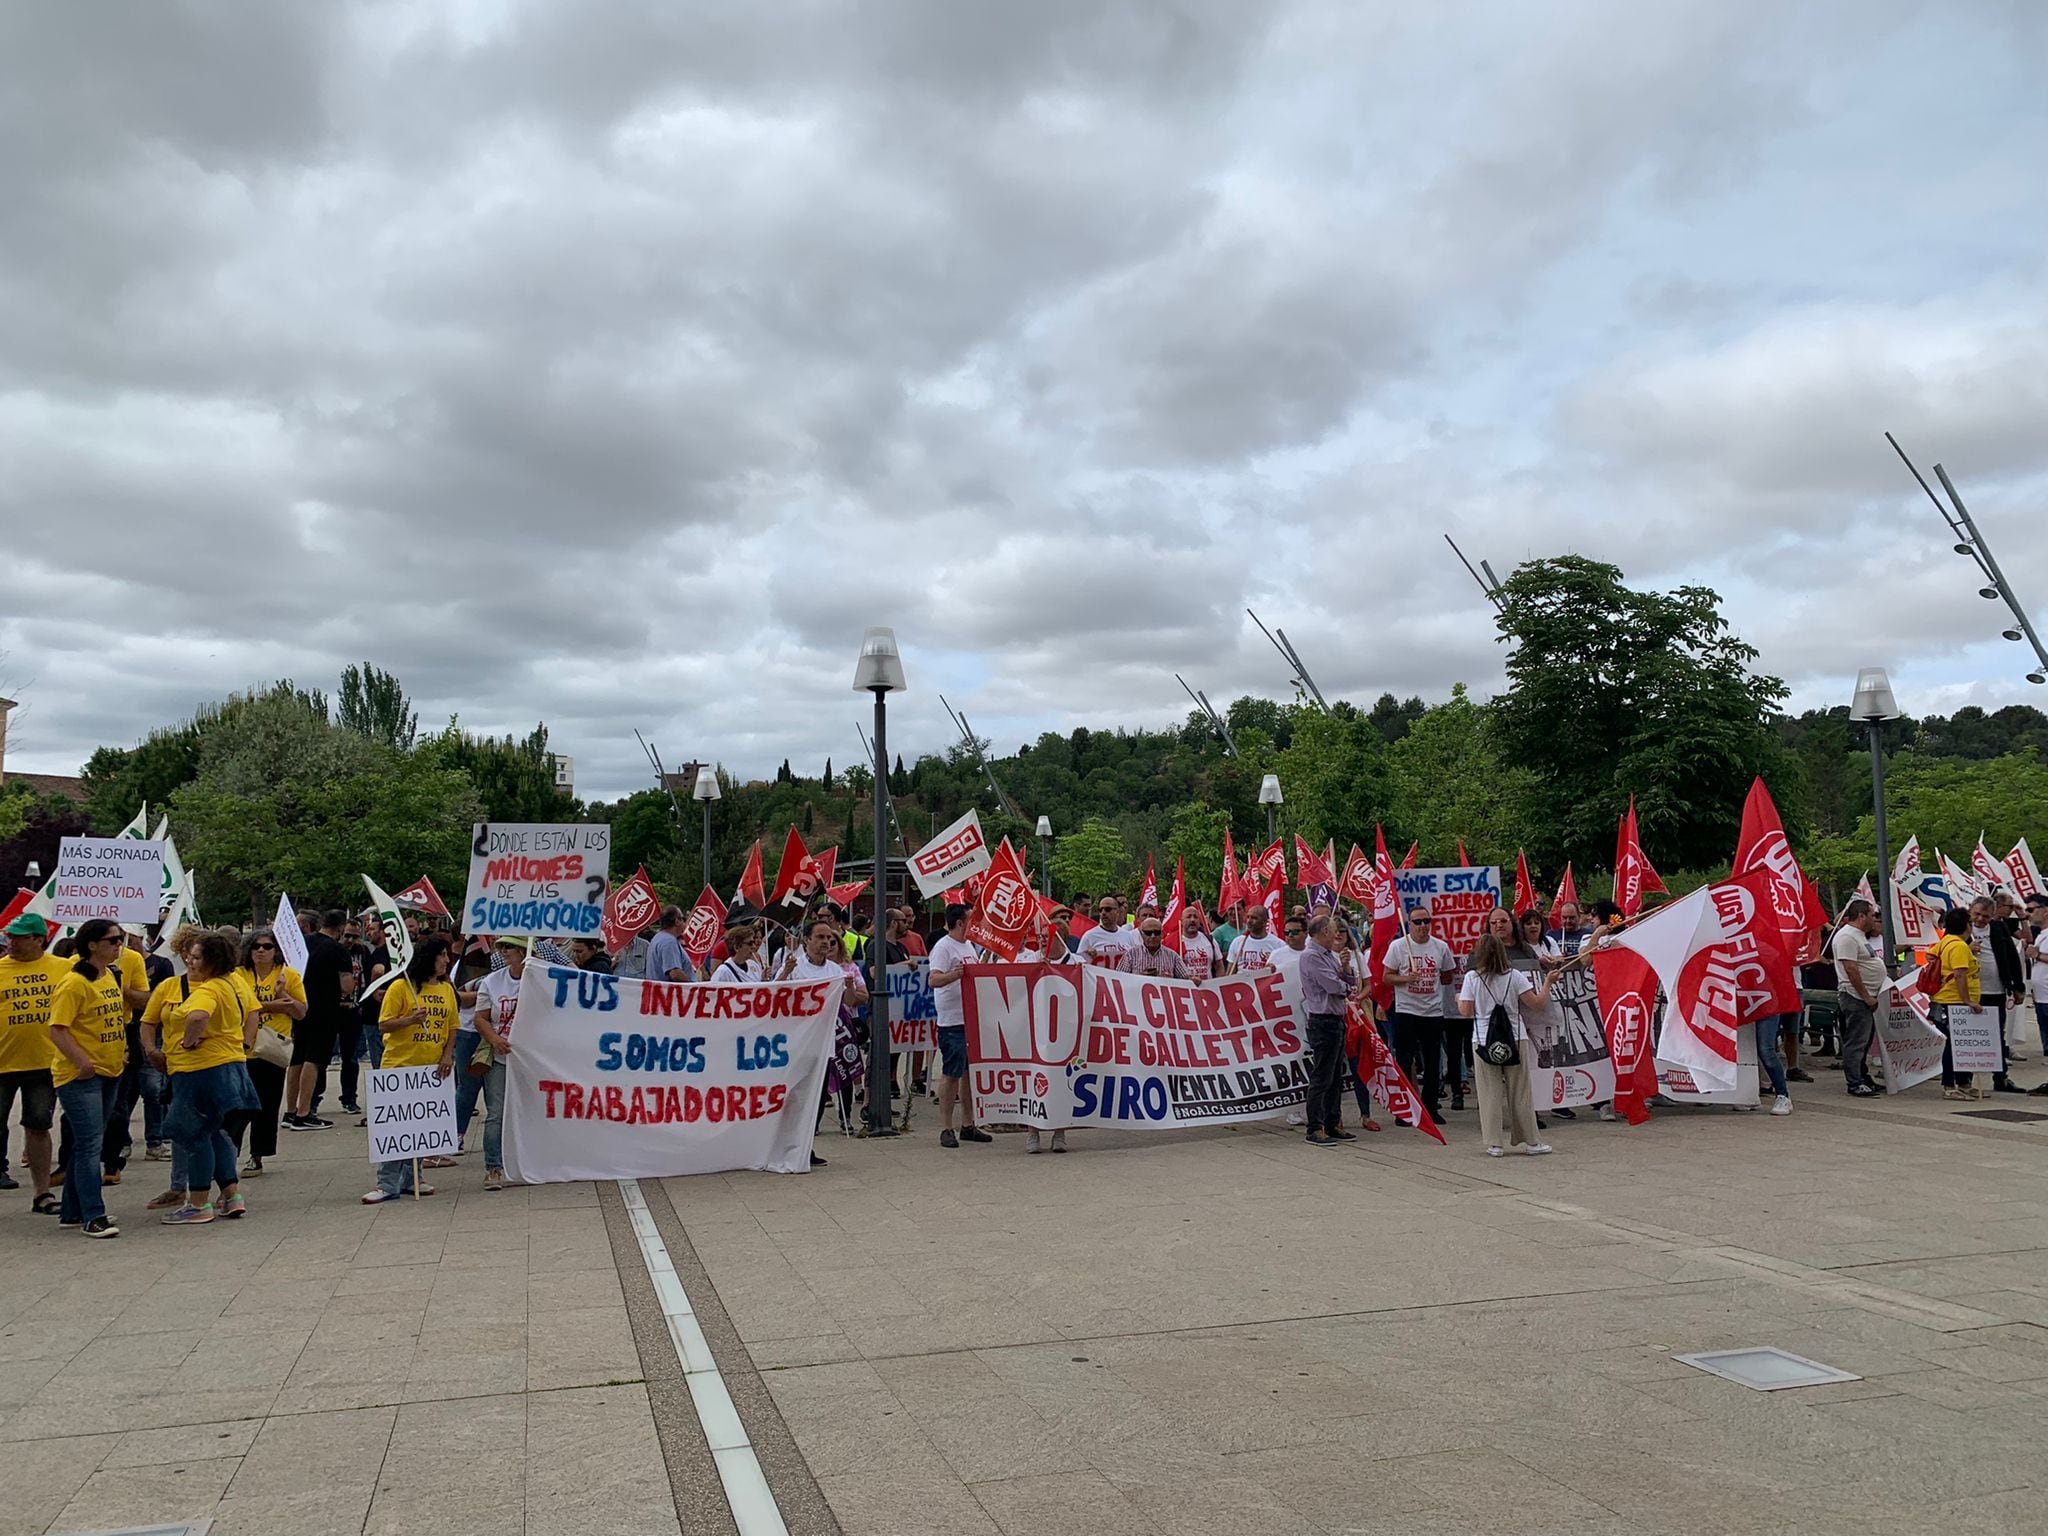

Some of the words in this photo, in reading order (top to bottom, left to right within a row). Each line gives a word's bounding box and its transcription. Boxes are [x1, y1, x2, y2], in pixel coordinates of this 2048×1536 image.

[61, 844, 92, 859] MÁS
[95, 847, 160, 861] JORNADA
[585, 831, 607, 851] LOS
[920, 830, 976, 871] CCOO
[60, 866, 123, 879] LABORAL
[941, 856, 976, 879] Palencia
[1444, 867, 1489, 892] ESTÁ
[58, 885, 109, 898] MENOS
[113, 886, 144, 899] VIDA
[498, 884, 516, 899] DE
[530, 883, 560, 898] LAS
[55, 904, 119, 917] FAMILIAR
[1711, 888, 1746, 929] UGT
[13, 974, 48, 984] TORO
[1725, 931, 1772, 1018] FICA
[12, 1000, 30, 1011] NO
[36, 999, 50, 1008] SE
[548, 966, 620, 1011] TUS
[640, 981, 831, 1019] INVERSORES
[1091, 975, 1139, 1026] AL
[1141, 972, 1293, 1032] CIERRE
[974, 974, 1080, 1064] NO
[889, 1019, 927, 1046] VETE
[1087, 1026, 1132, 1066] DE
[1139, 1019, 1302, 1068] GALLETAS
[596, 1032, 706, 1073] SOMOS
[736, 1033, 790, 1071] LOS
[373, 1073, 400, 1093] NO
[405, 1066, 442, 1090] MÁS
[975, 1070, 1031, 1095] UGT
[1168, 1073, 1236, 1103] VENTA
[1235, 1067, 1271, 1097] DE
[539, 1080, 787, 1125] TRABAJADORES
[1019, 1098, 1048, 1120] FICA
[1072, 1073, 1168, 1121] SIRO
[374, 1100, 451, 1125] ZAMORA
[375, 1129, 453, 1155] VACIADA
